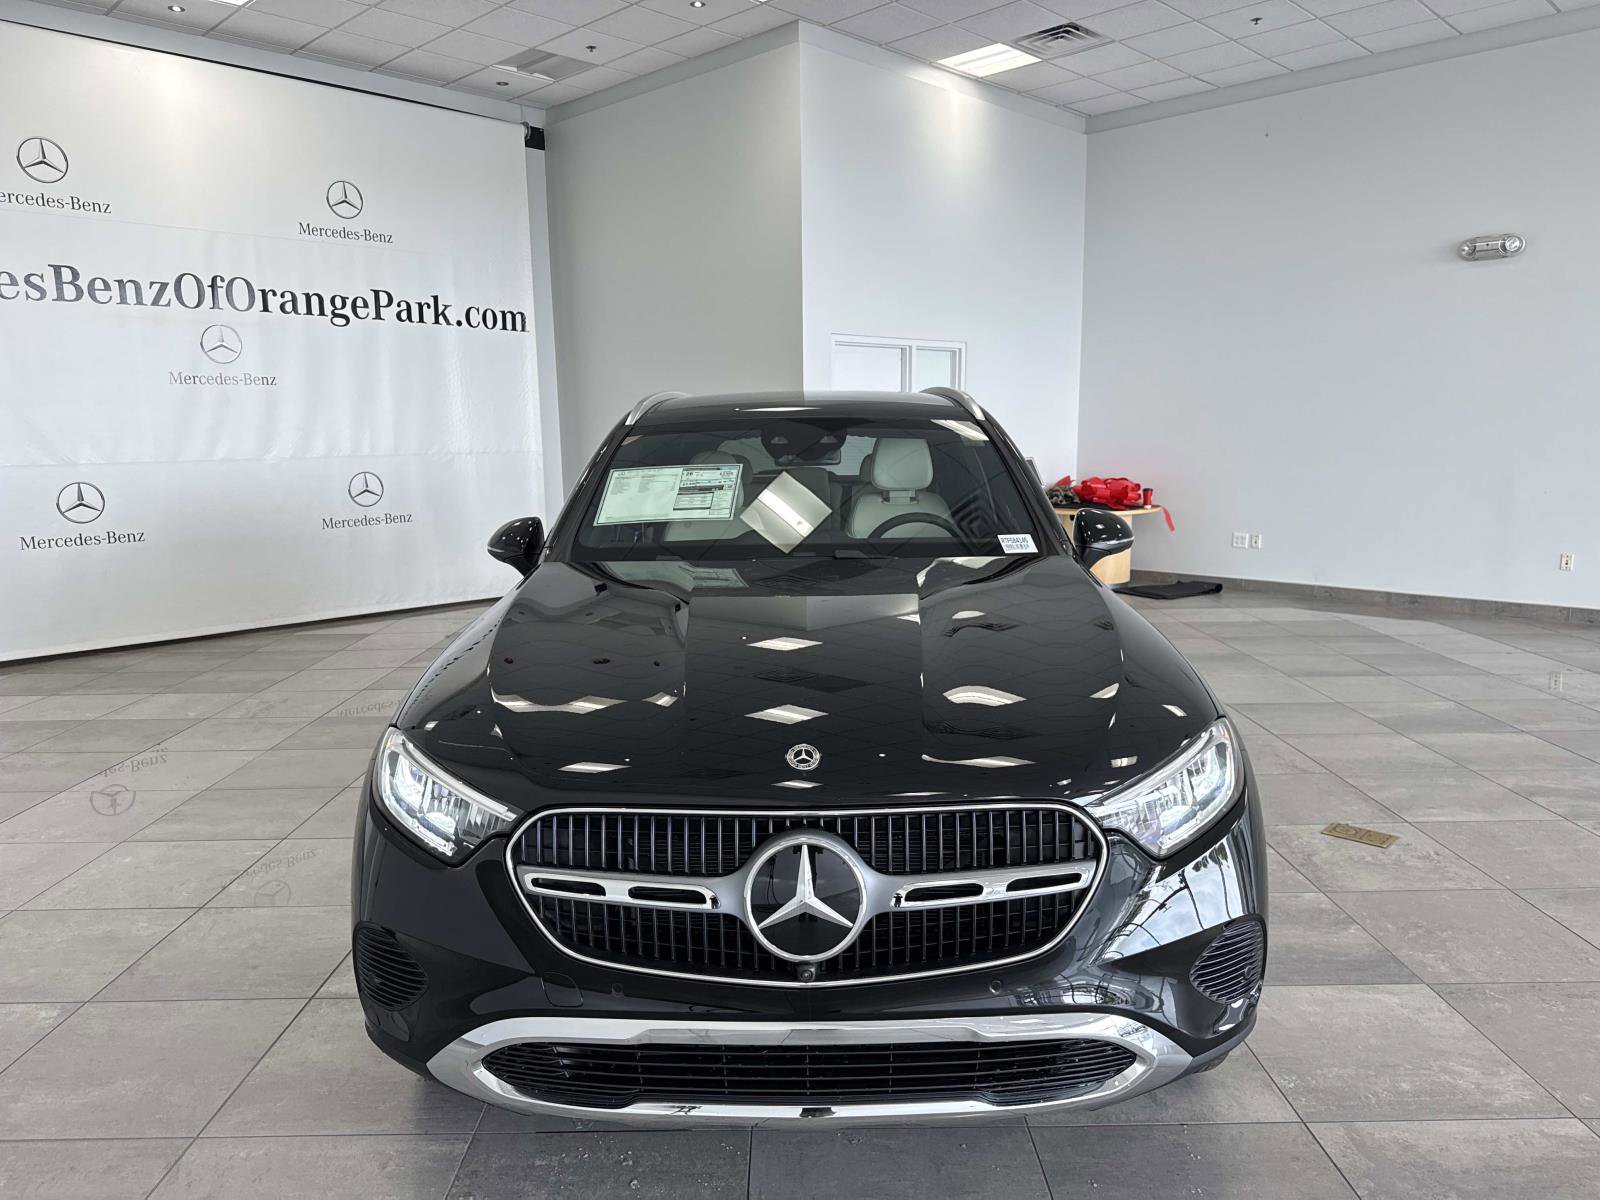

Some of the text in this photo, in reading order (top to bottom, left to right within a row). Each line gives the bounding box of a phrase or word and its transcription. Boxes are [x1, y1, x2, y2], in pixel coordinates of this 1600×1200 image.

[298, 222, 394, 244] Mercedes-Benz
[168, 371, 278, 388] Mercedes-Benz
[321, 512, 413, 530] Mercedes-Benz
[19, 529, 146, 551] Mercedes-Benz
